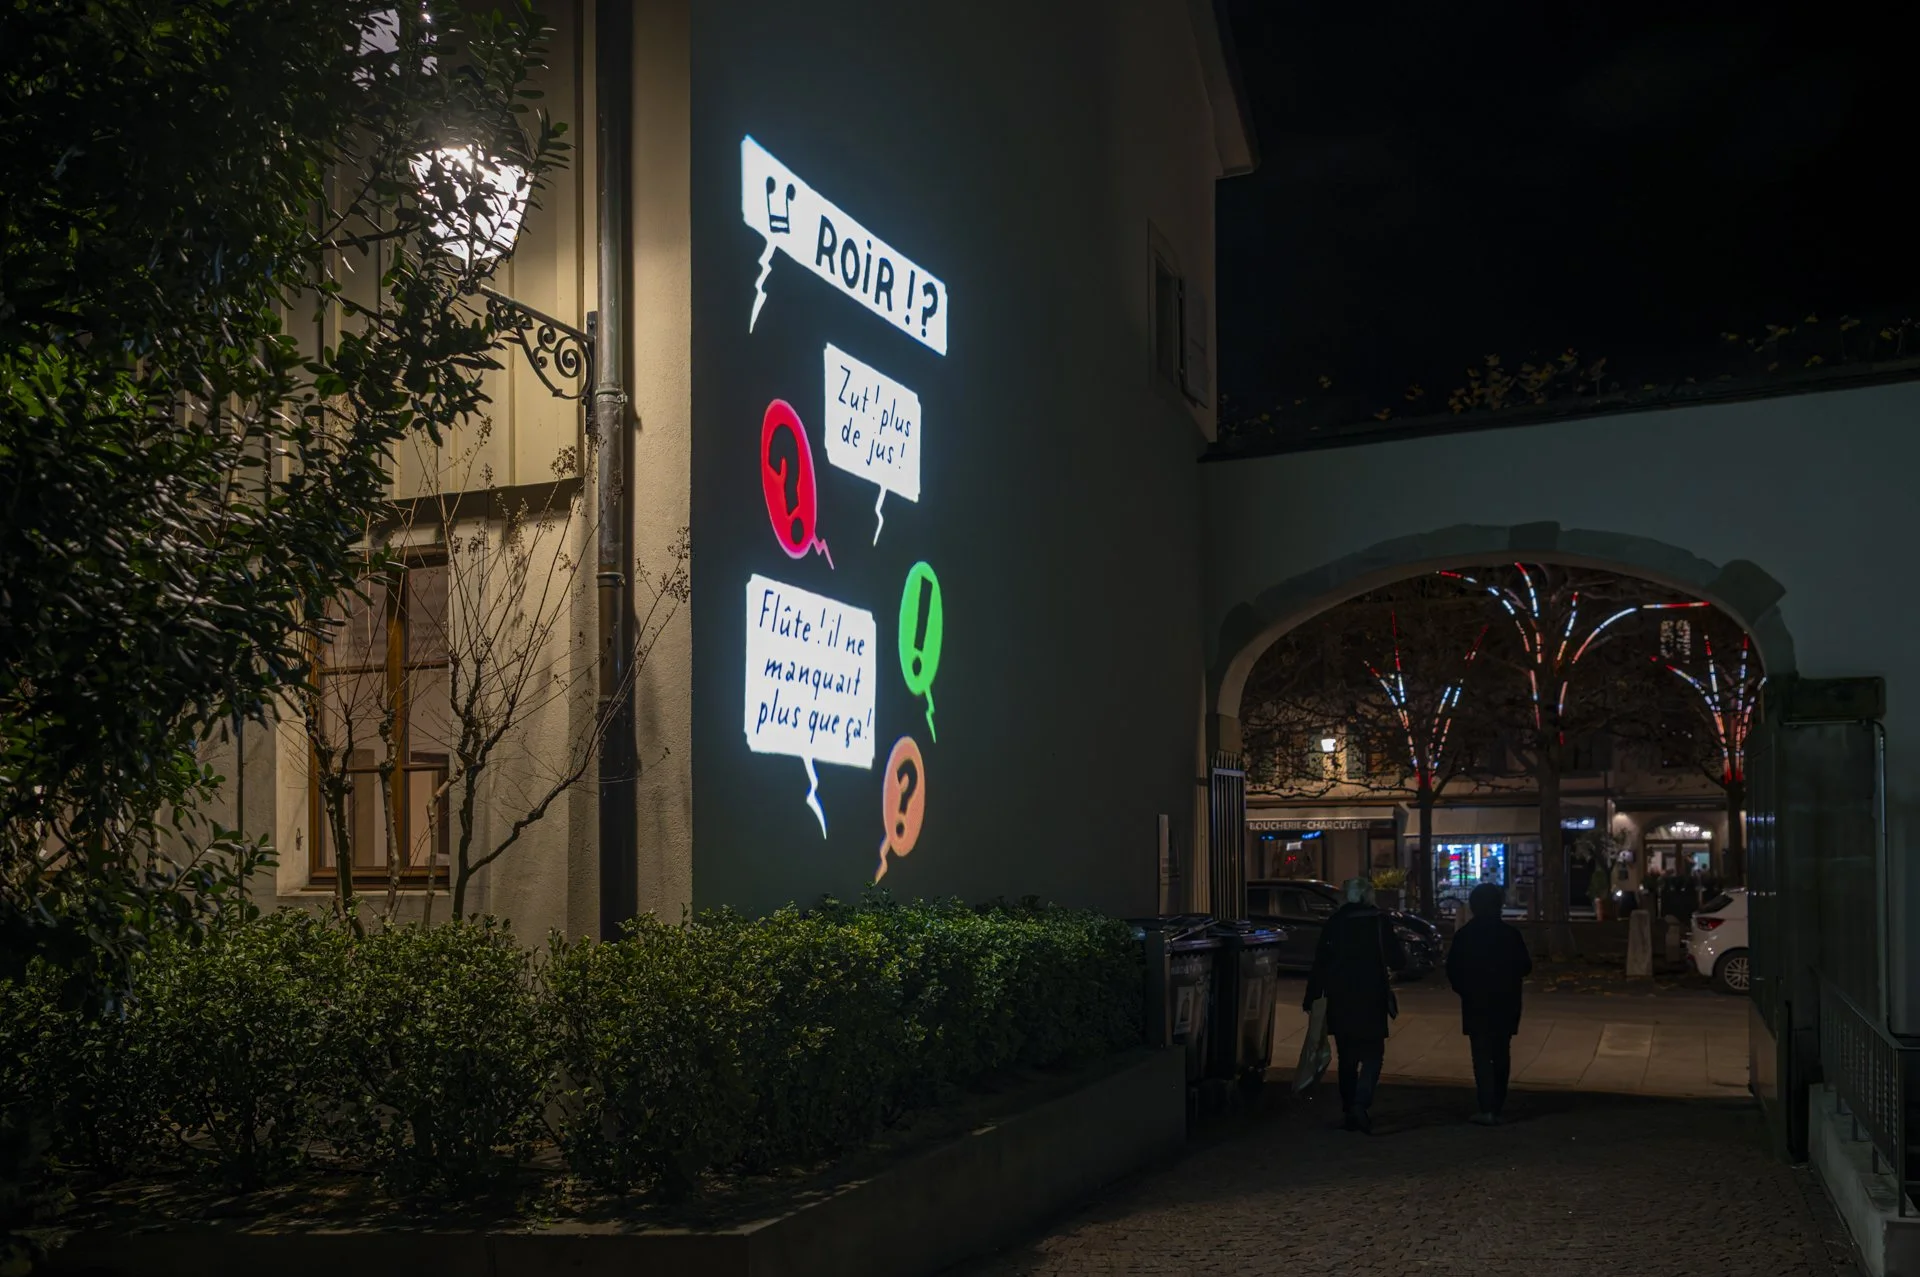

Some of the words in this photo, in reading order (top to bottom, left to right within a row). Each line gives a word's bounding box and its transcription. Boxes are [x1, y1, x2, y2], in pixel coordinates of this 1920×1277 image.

[841, 417, 861, 448] de
[879, 398, 912, 437] plus
[846, 635, 865, 656] ne
[764, 656, 862, 700] manquait
[756, 688, 801, 734] plus
[808, 707, 839, 744] que
[845, 707, 873, 748] ça!
